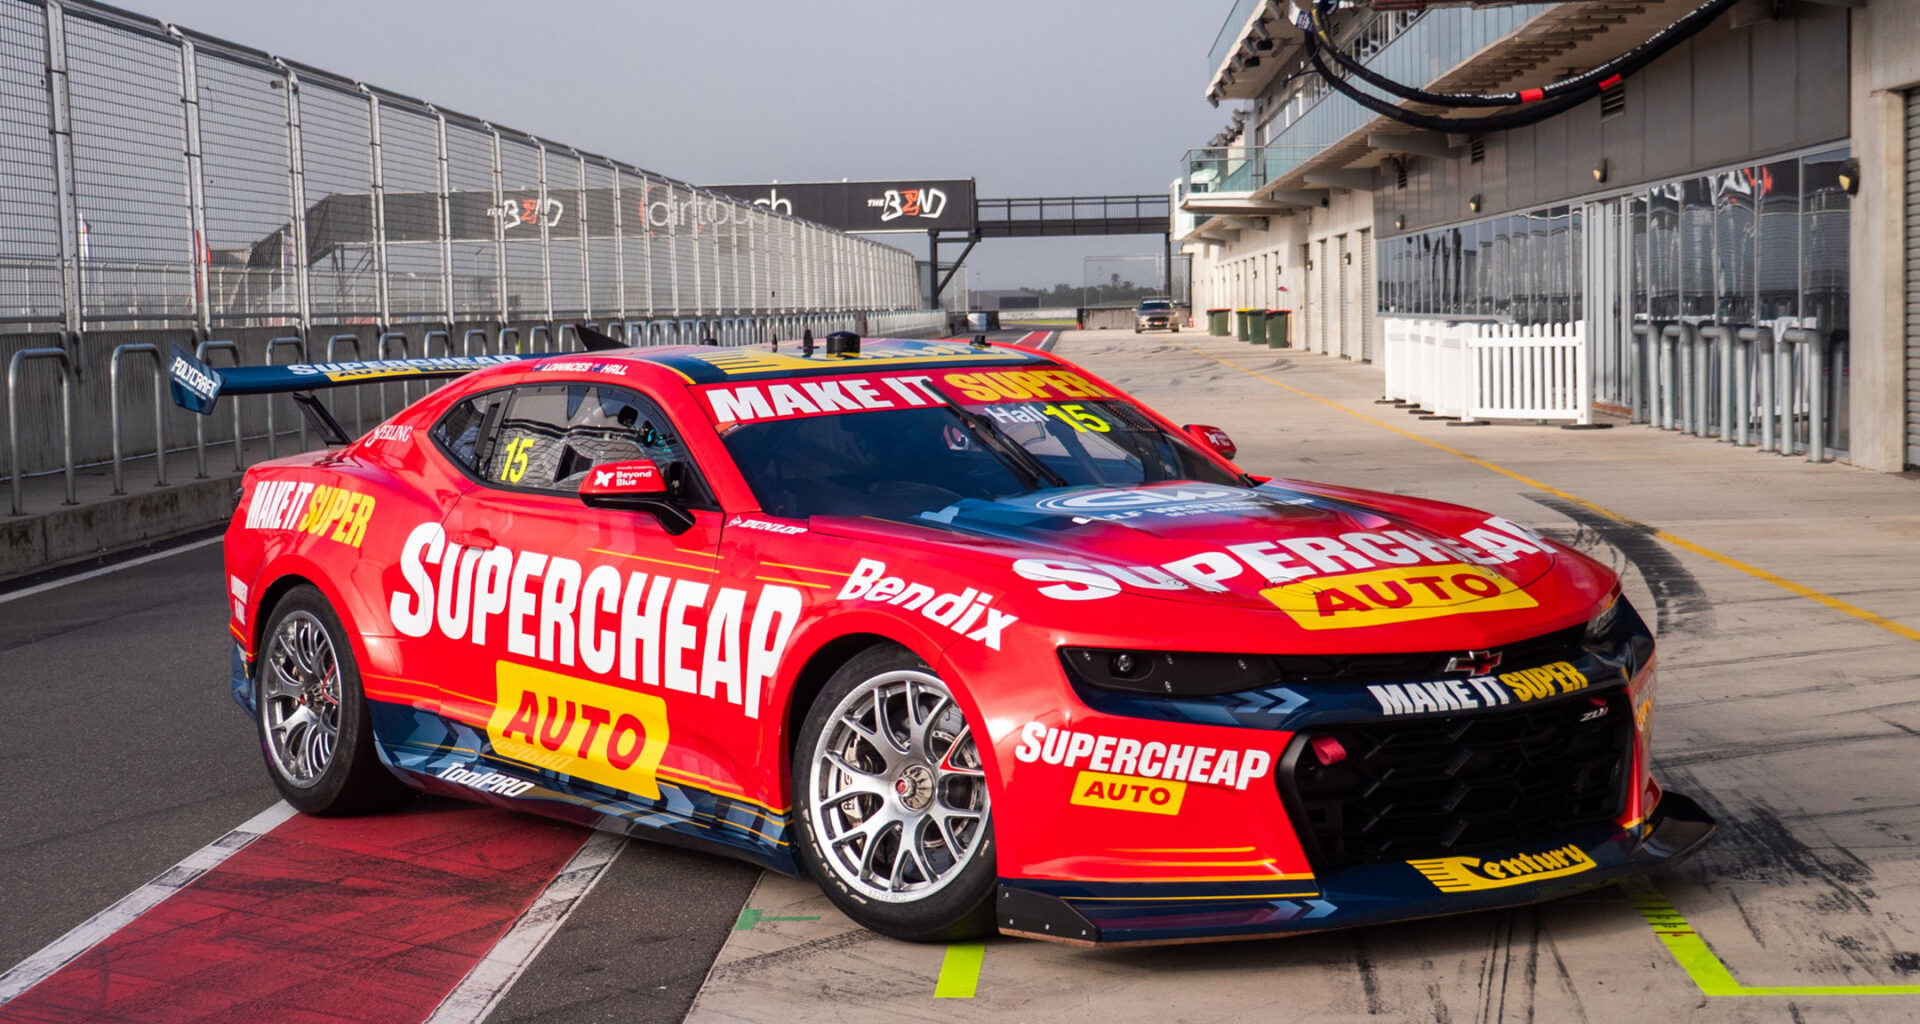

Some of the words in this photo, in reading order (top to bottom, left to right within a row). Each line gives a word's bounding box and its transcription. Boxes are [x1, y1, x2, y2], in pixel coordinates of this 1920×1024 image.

[881, 188, 947, 222] BEND
[171, 356, 217, 399] POLYCRAFT
[541, 362, 594, 372] LOWNDES
[600, 364, 628, 376] HALL
[706, 379, 893, 423] MAKE
[880, 375, 946, 406] IT
[943, 370, 1112, 402] SUPER
[984, 406, 1050, 424] Hall
[1043, 405, 1111, 433] 15
[501, 437, 535, 483] 15
[616, 470, 652, 480] Beyond
[616, 479, 637, 487] Blue
[245, 481, 297, 529] MAKE
[282, 482, 315, 530] IT
[298, 484, 376, 548] SUPER
[740, 519, 808, 535] DUNLOP
[1013, 516, 1558, 601] SUPERCHEAP
[836, 558, 1019, 651] Bendix
[1315, 572, 1501, 617] AUTO
[390, 521, 802, 719] SUPERCHEAP
[1367, 680, 1474, 715] MAKE
[1471, 676, 1510, 706] IT
[1499, 661, 1589, 702] SUPER
[502, 690, 647, 770] AUTO
[437, 762, 535, 797] ToolPRO
[1015, 722, 1270, 791] SUPERCHEAP
[1083, 781, 1170, 806] AUTO
[1405, 843, 1597, 893] Century
